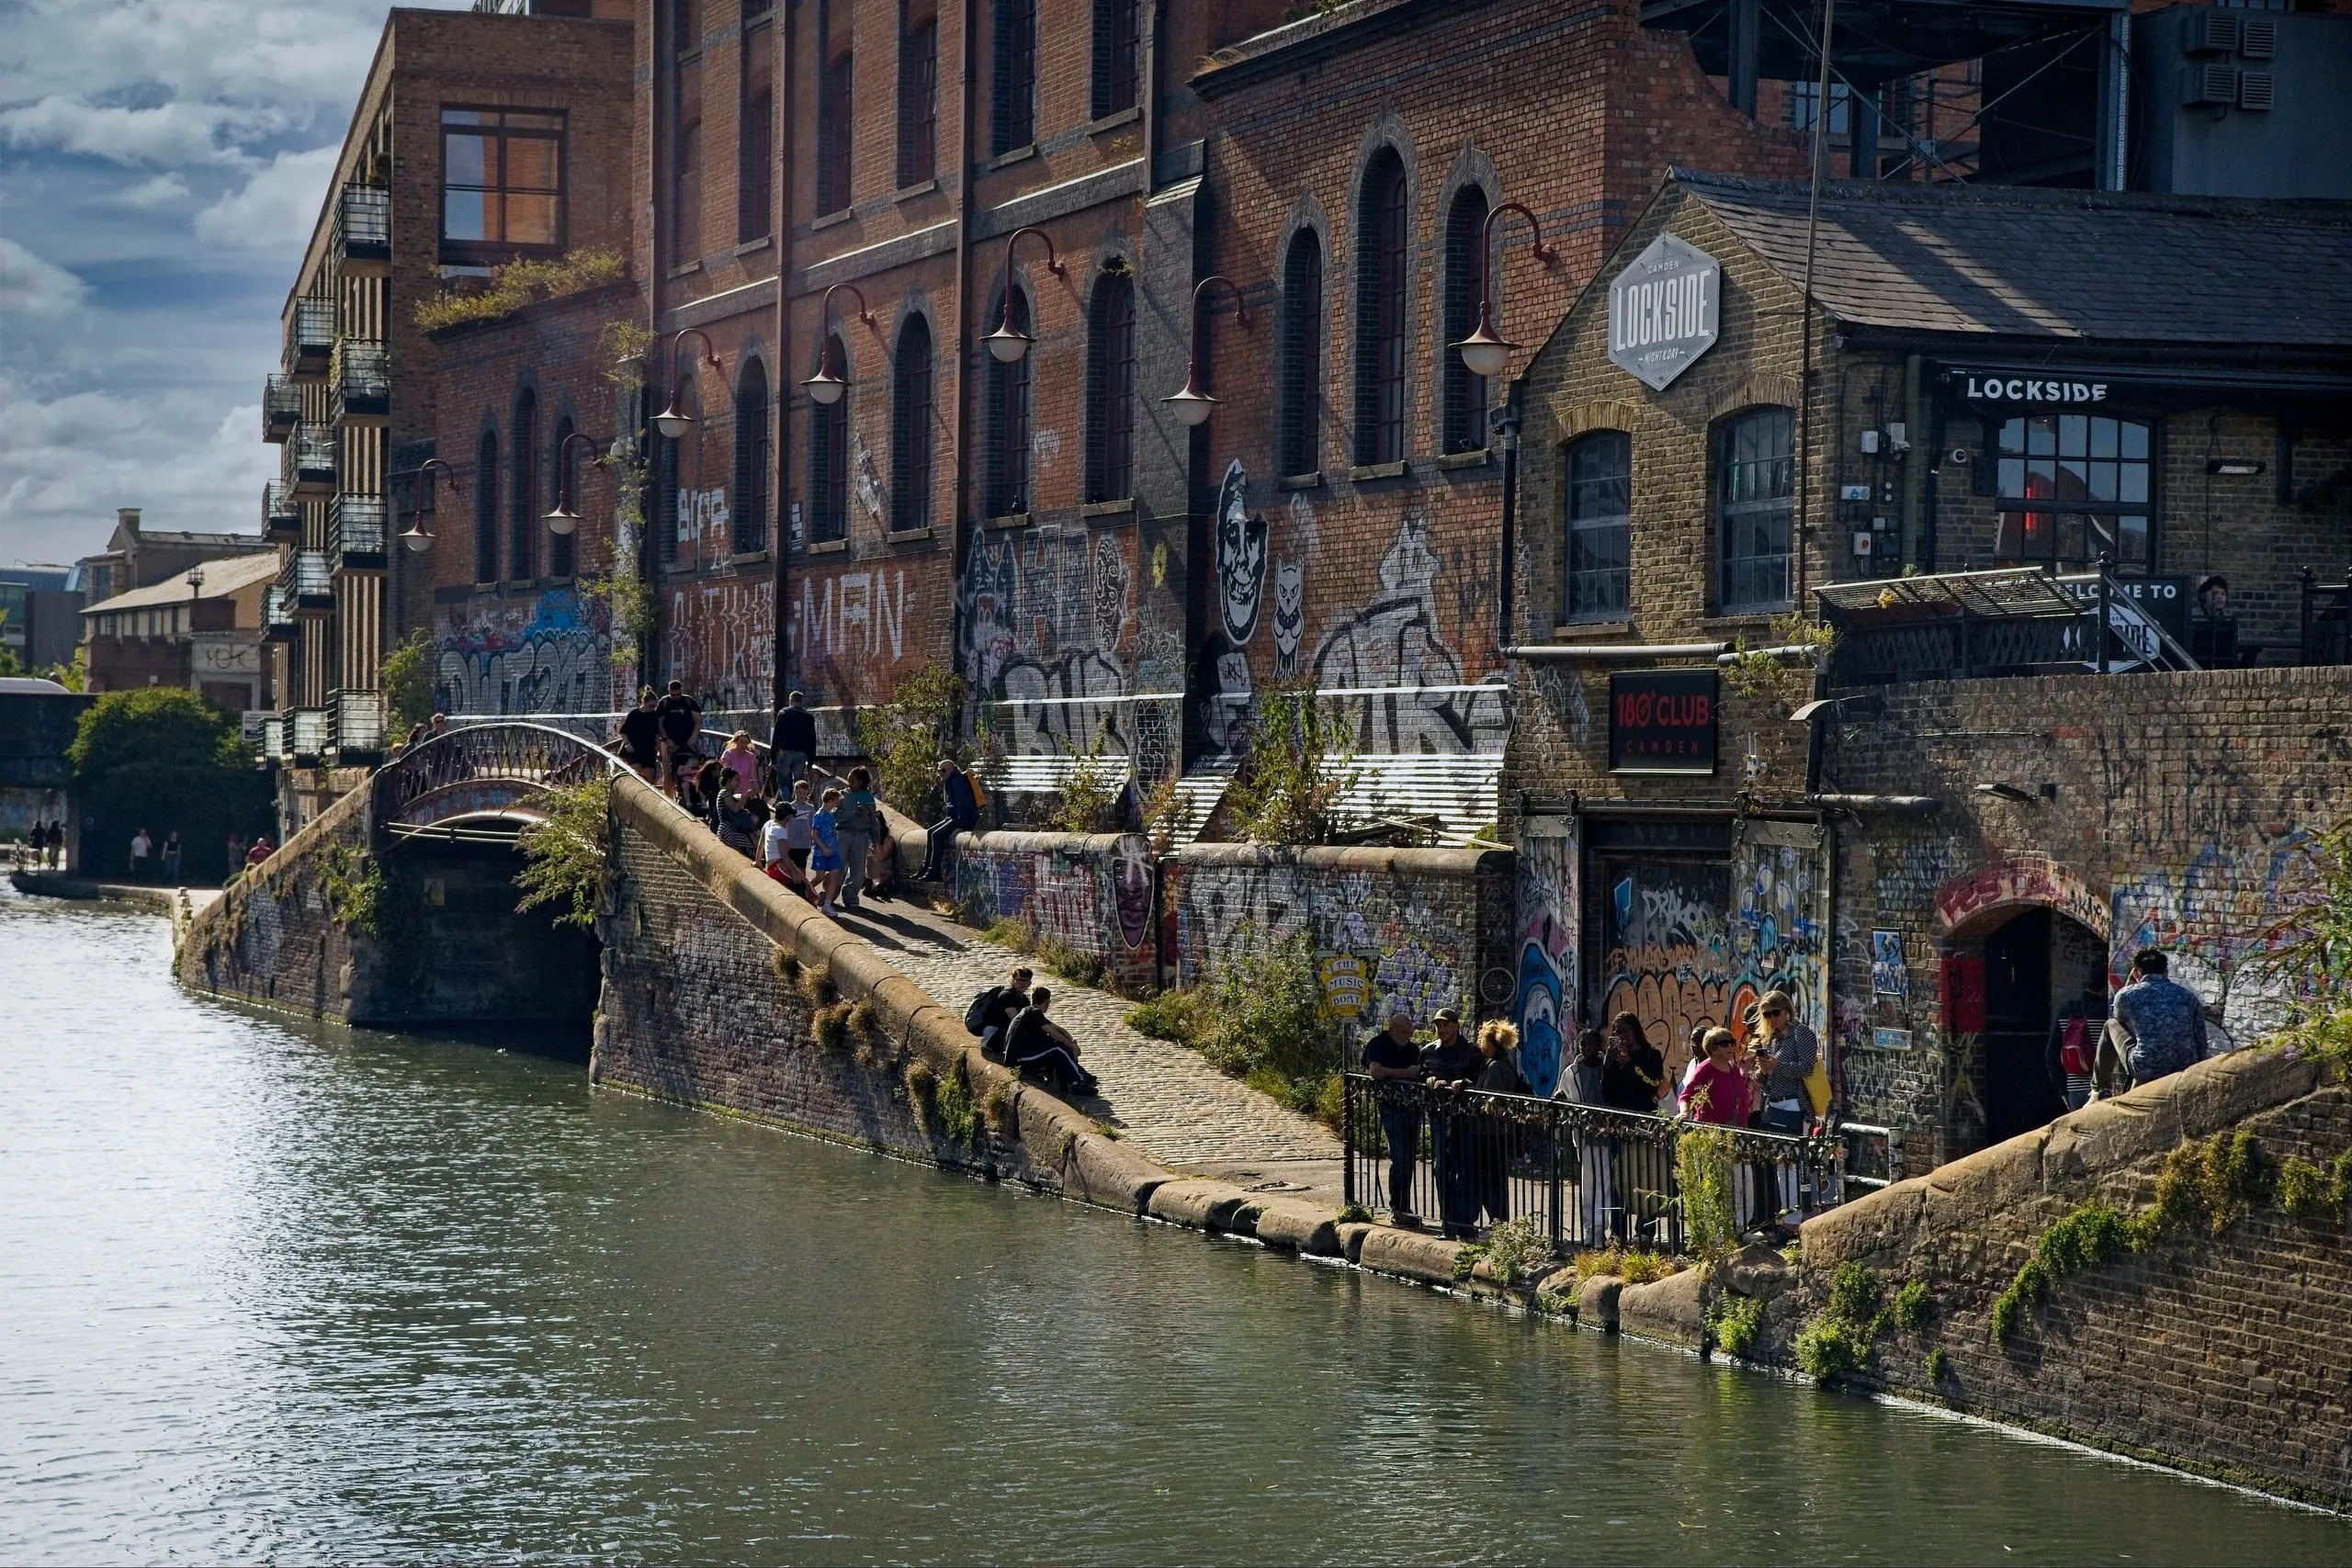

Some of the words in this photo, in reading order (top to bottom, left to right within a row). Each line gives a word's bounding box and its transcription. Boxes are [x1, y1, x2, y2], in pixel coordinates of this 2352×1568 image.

[1647, 260, 1680, 274] CAMDEN
[1616, 269, 1712, 352] LOCKSIDE
[1967, 378, 2108, 402] LOCKSIDE
[2150, 584, 2177, 599] TO
[1657, 694, 1710, 727] CLUB
[1626, 740, 1700, 754] CAMDEN
[1336, 960, 1357, 970] THE
[1329, 976, 1364, 990] MUSIC
[1333, 995, 1361, 1006] BOAT
